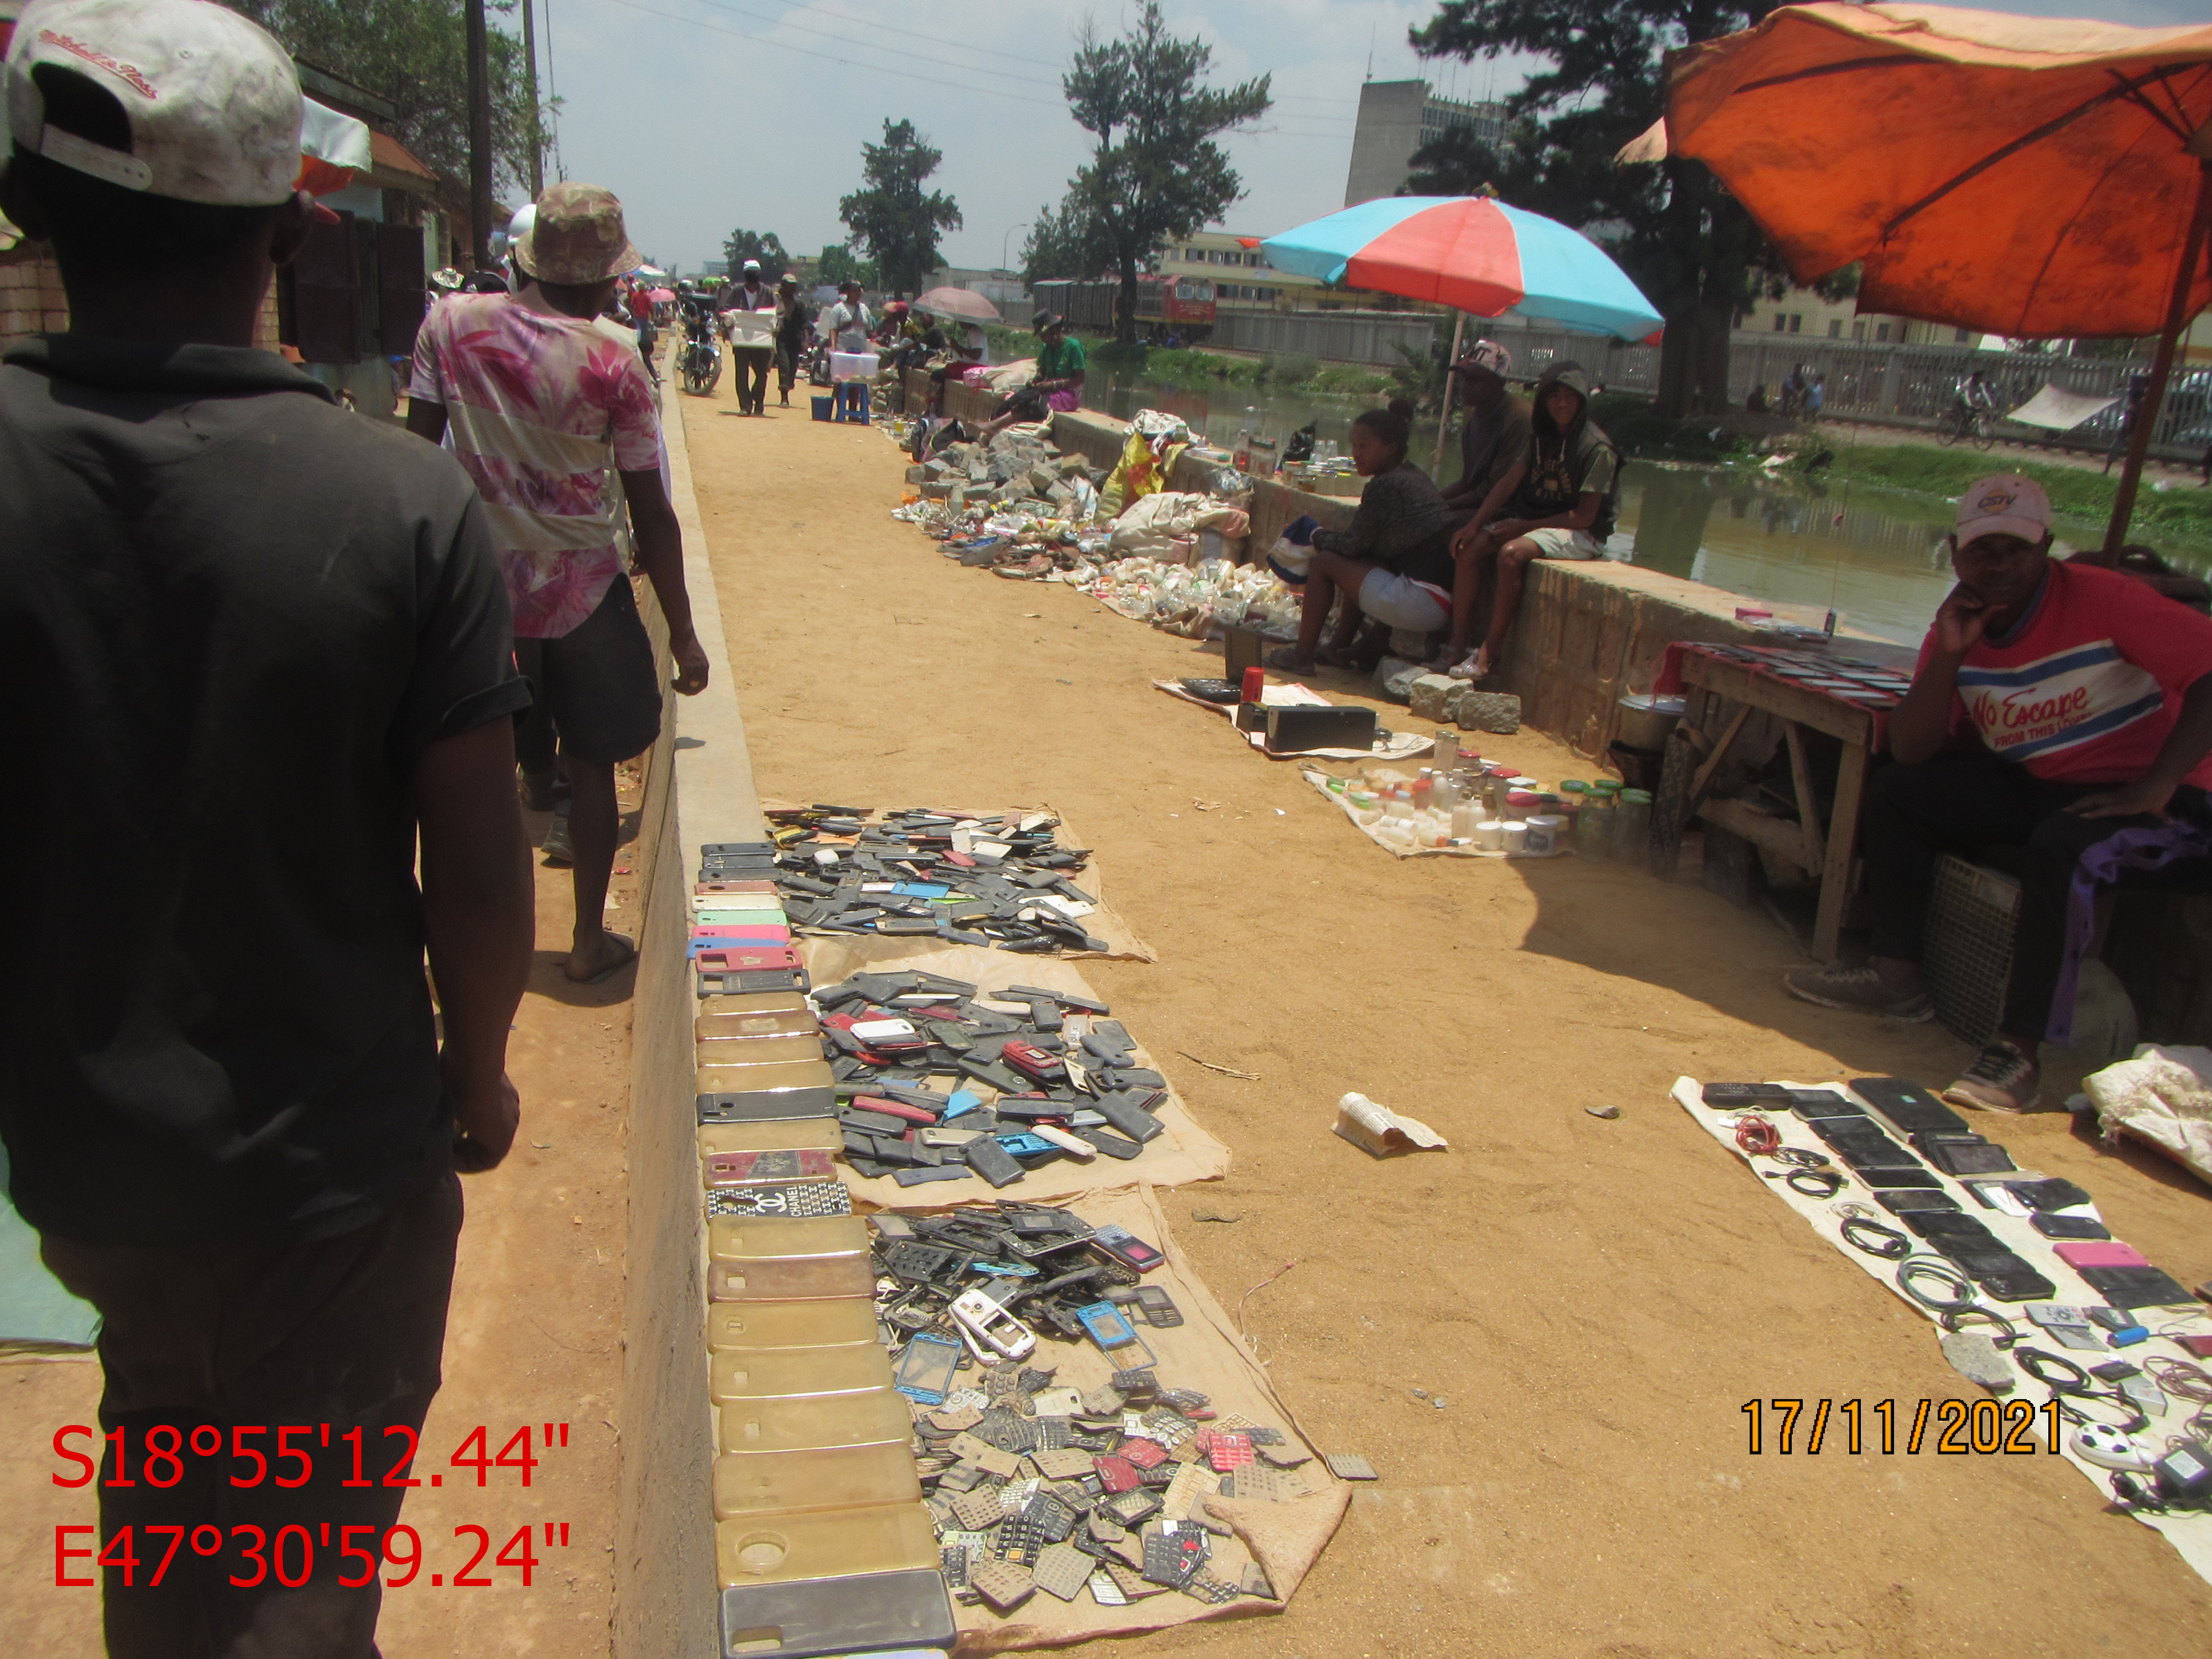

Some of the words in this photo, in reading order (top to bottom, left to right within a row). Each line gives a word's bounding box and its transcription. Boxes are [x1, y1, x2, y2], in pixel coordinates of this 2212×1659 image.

[1973, 690, 1997, 734] No
[2002, 687, 2093, 729] Escape
[1994, 731, 2025, 748] FROM
[2028, 723, 2054, 739] THIS
[786, 1186, 802, 1217] CHANEL
